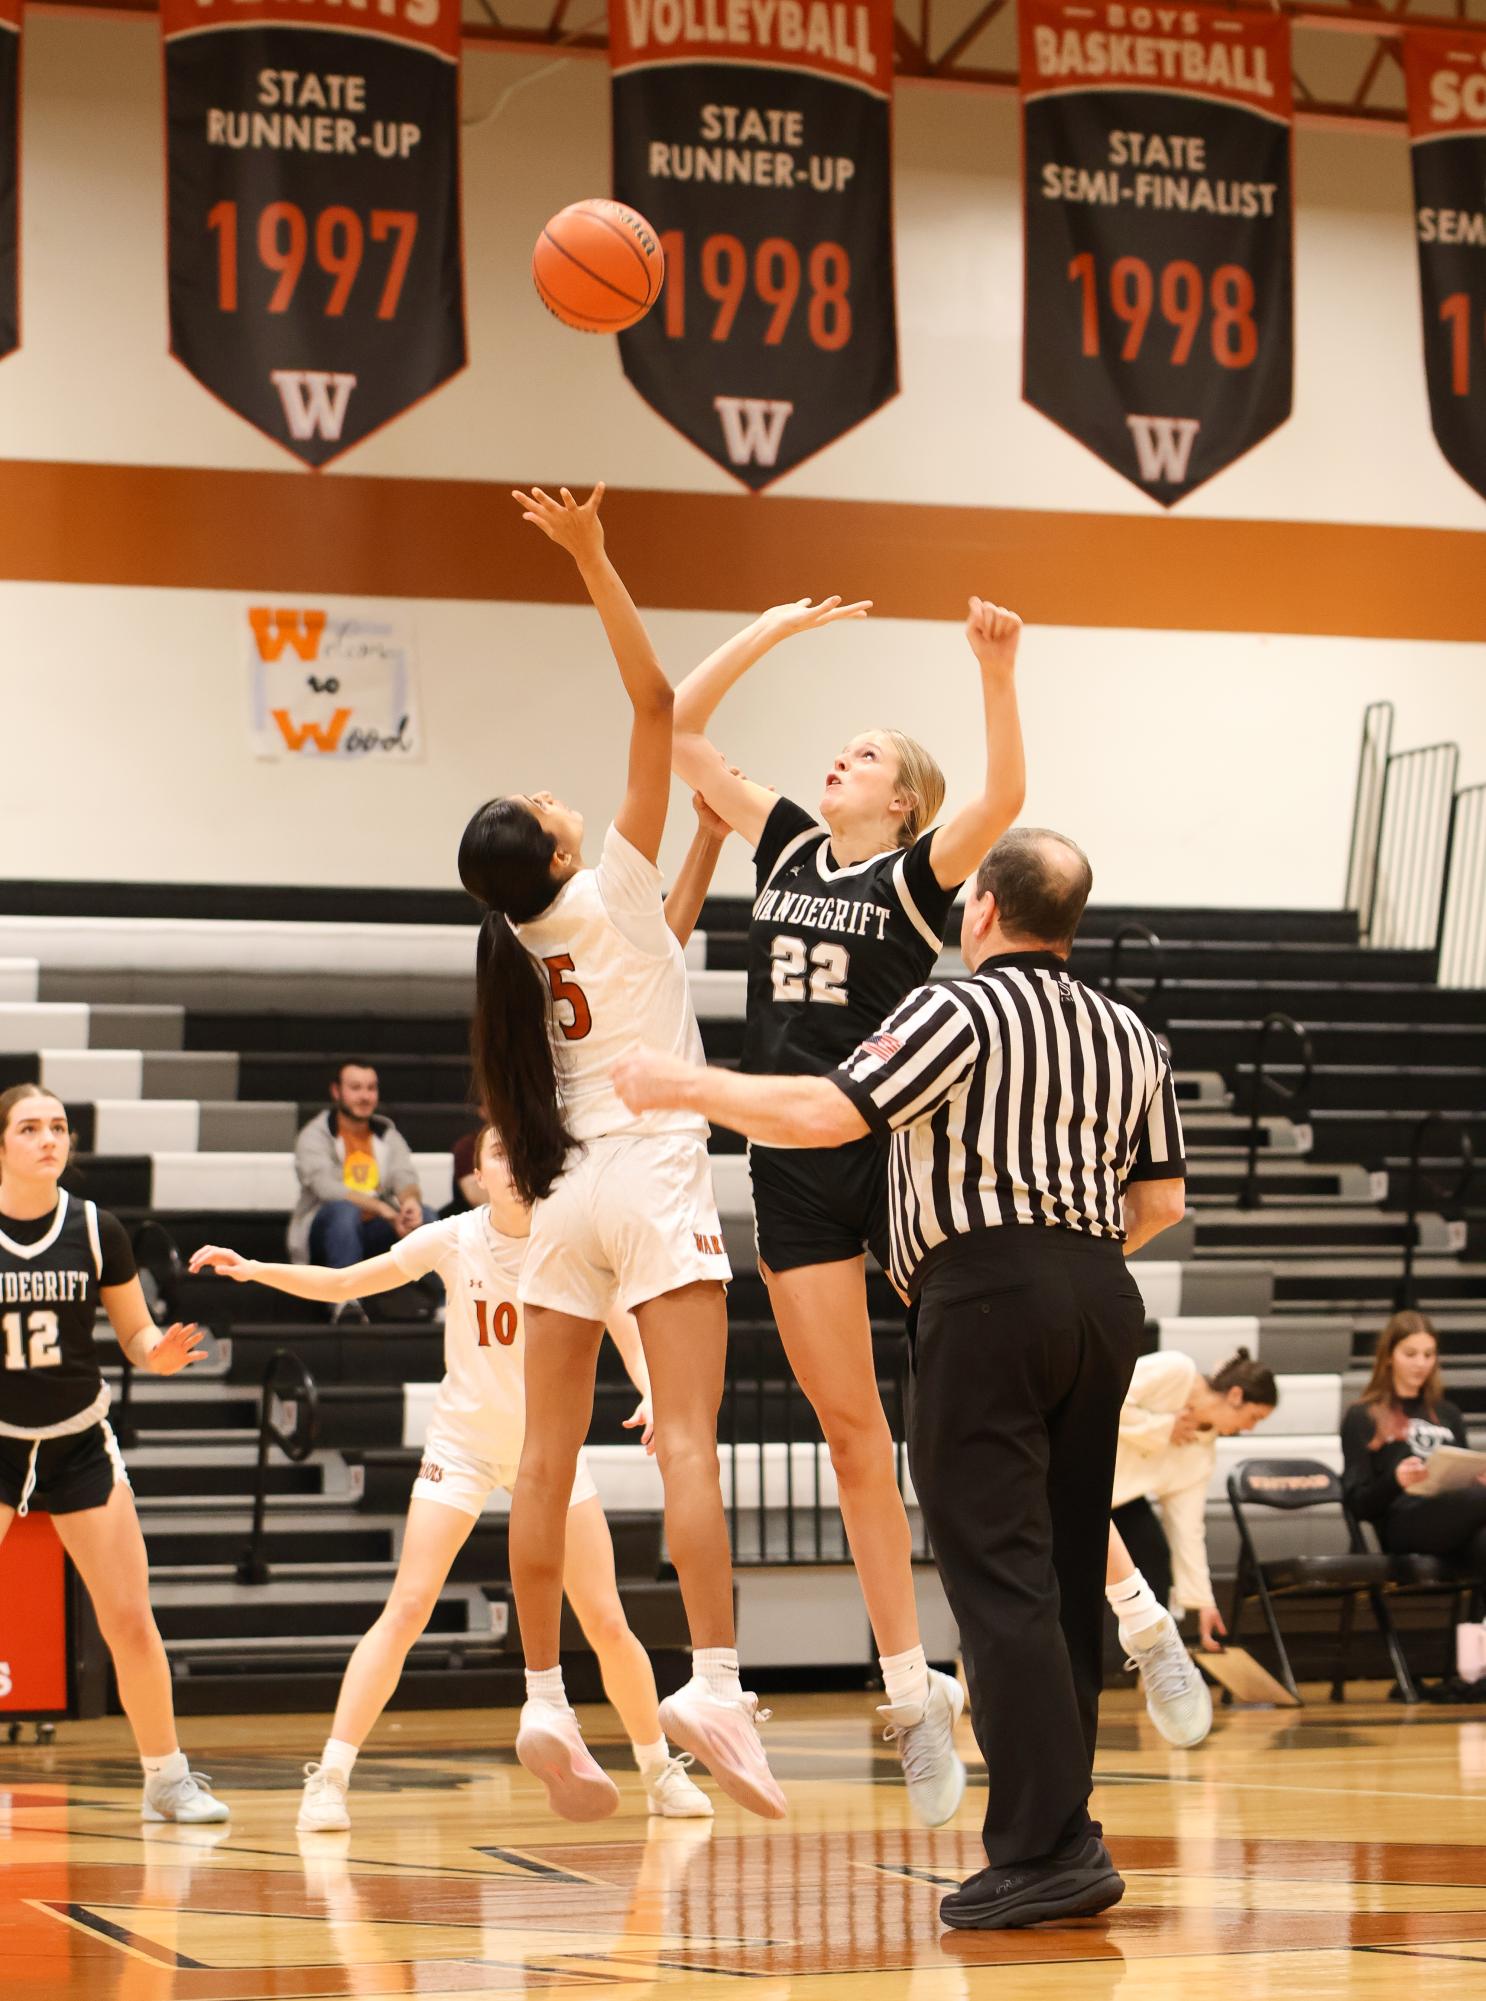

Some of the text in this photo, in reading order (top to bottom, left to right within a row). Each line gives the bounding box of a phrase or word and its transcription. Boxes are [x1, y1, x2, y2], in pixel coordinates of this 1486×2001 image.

[625, 0, 877, 75] VOLLEYBALL
[1106, 3, 1199, 34] BOYS
[258, 69, 366, 111] STATE
[1033, 25, 1275, 97] BASKETBALL
[207, 108, 421, 158] RUNNER-UP
[702, 104, 804, 146] STATE
[1108, 130, 1206, 170] STATE
[649, 142, 855, 193] RUNNER-UP
[1041, 163, 1277, 218] SEMI-FINALIST
[207, 200, 419, 320] 1997
[660, 230, 853, 352] 1998
[1068, 251, 1259, 370] 1998
[271, 369, 357, 440] W
[714, 396, 793, 466] W
[1126, 414, 1200, 483] W
[308, 674, 340, 695] to
[755, 889, 891, 940] VANDEGRIFT
[543, 953, 592, 1040] 5
[770, 934, 850, 1006] 22
[2, 1311, 62, 1370] 12
[474, 1300, 518, 1347] 10
